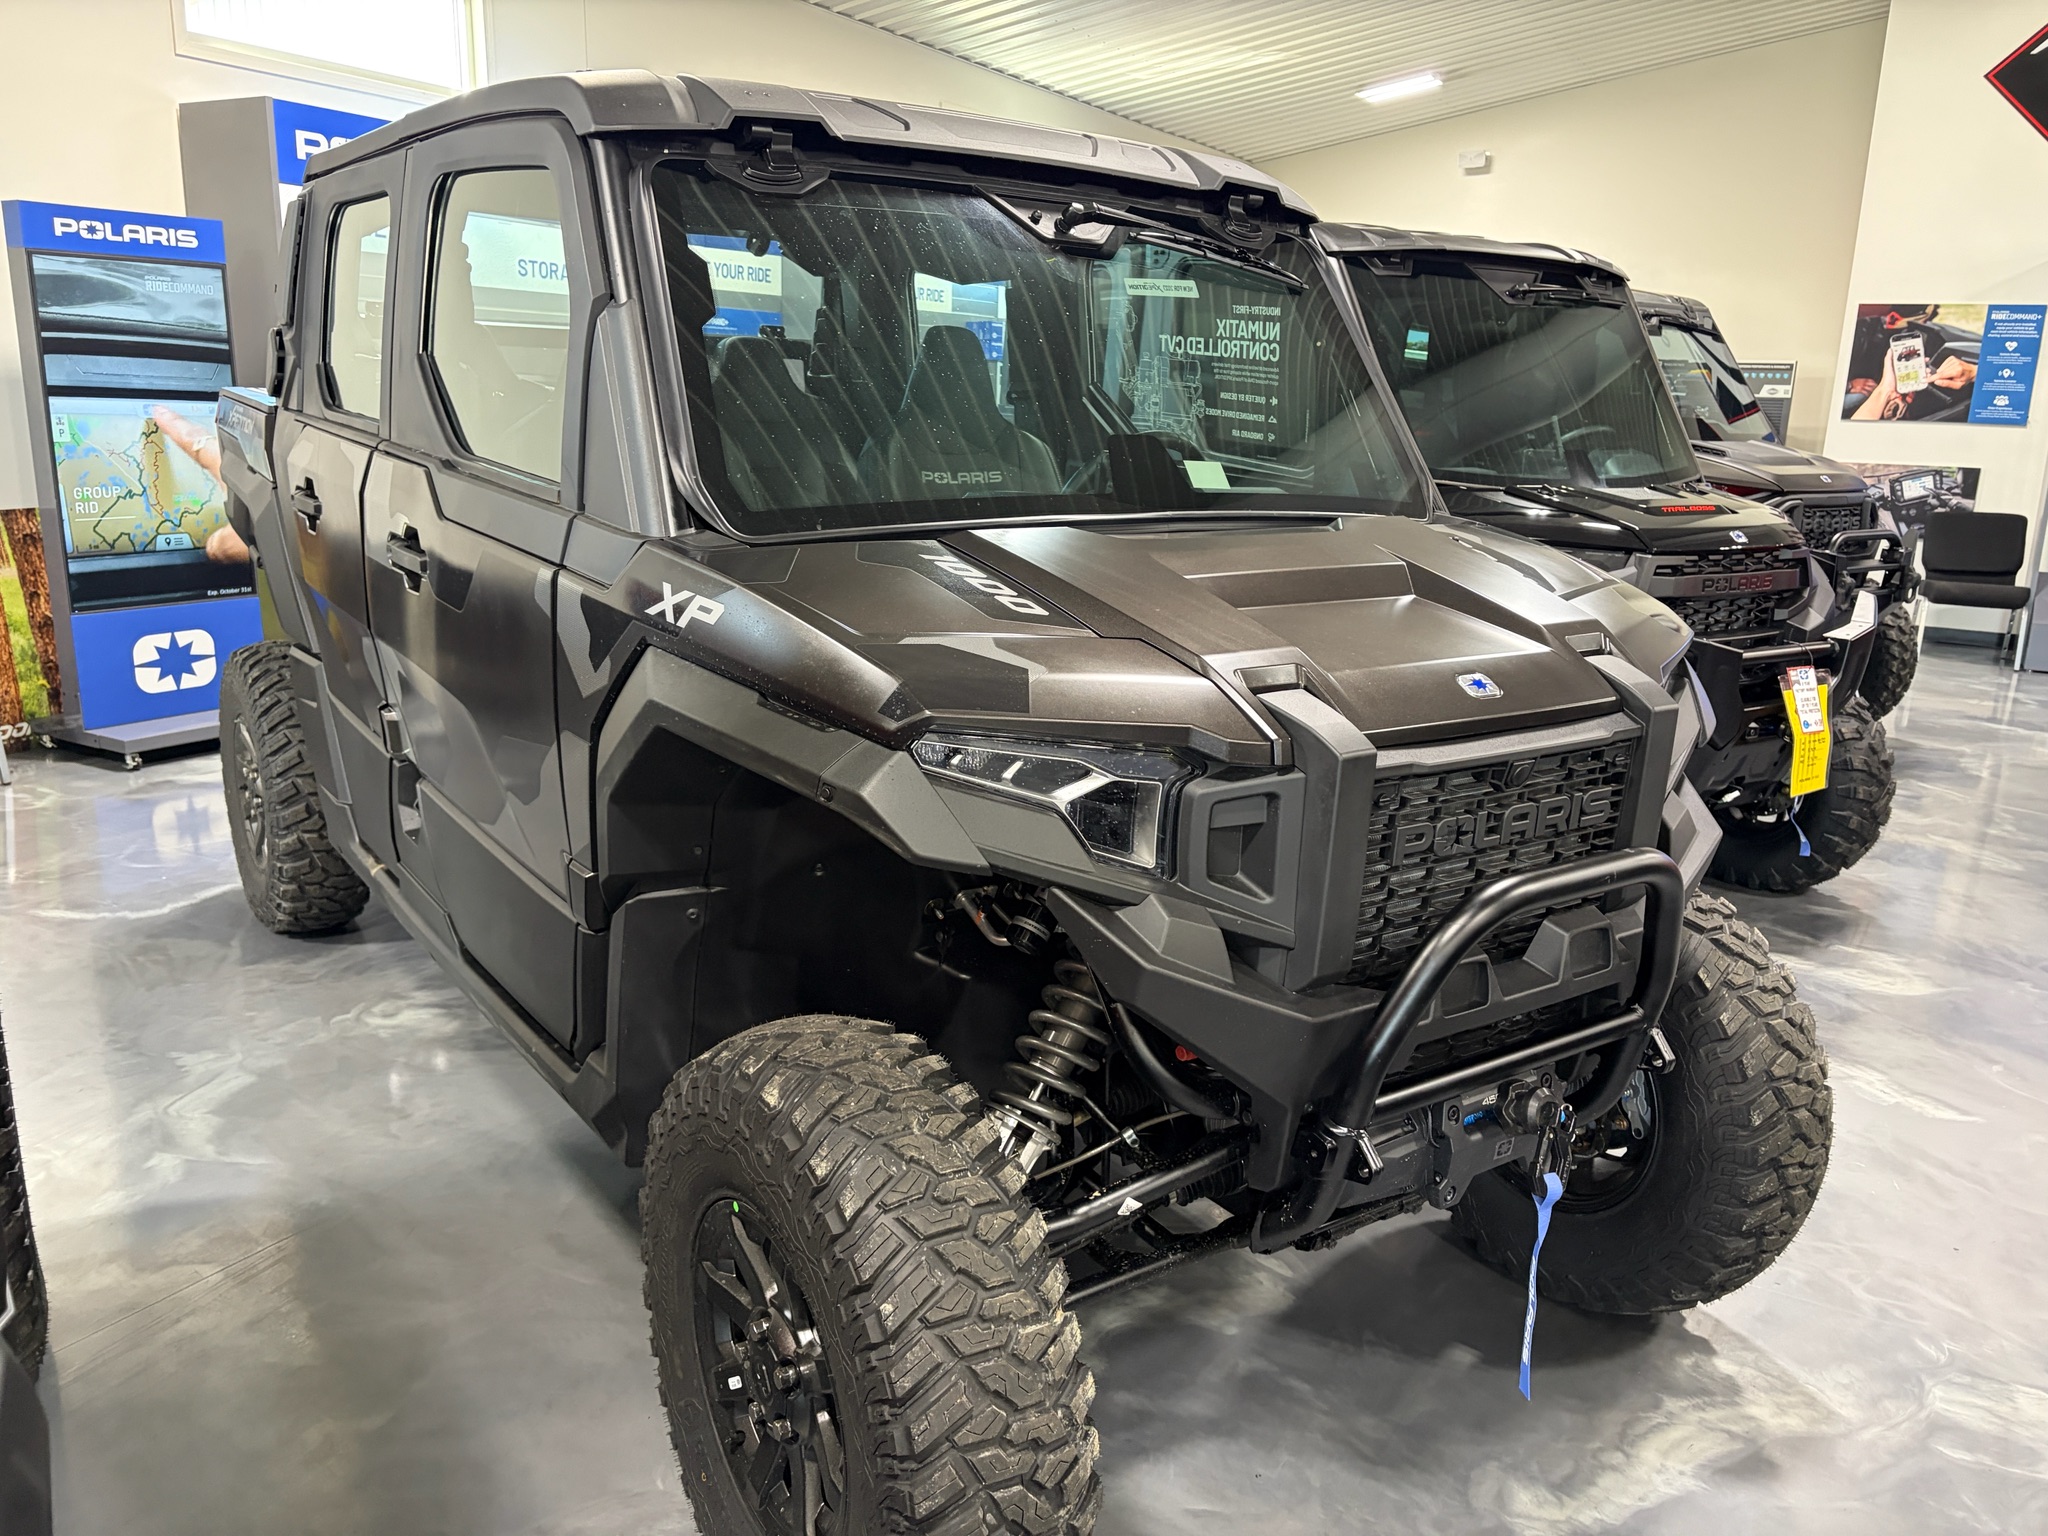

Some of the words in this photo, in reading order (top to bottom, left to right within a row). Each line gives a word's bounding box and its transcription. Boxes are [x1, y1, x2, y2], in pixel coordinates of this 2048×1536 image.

[53, 216, 199, 249] POLARIS
[714, 263, 745, 280] YOUR
[747, 266, 772, 283] RIDE
[926, 288, 944, 303] RIDE
[921, 470, 1003, 485] POLARIS
[73, 485, 122, 500] GROUP
[75, 501, 99, 514] RID
[1802, 516, 1861, 533] POLARIS
[918, 553, 1050, 616] 1000
[1701, 575, 1773, 594] POLARIS
[643, 581, 725, 629] XP
[1393, 786, 1613, 867] POLARIS
